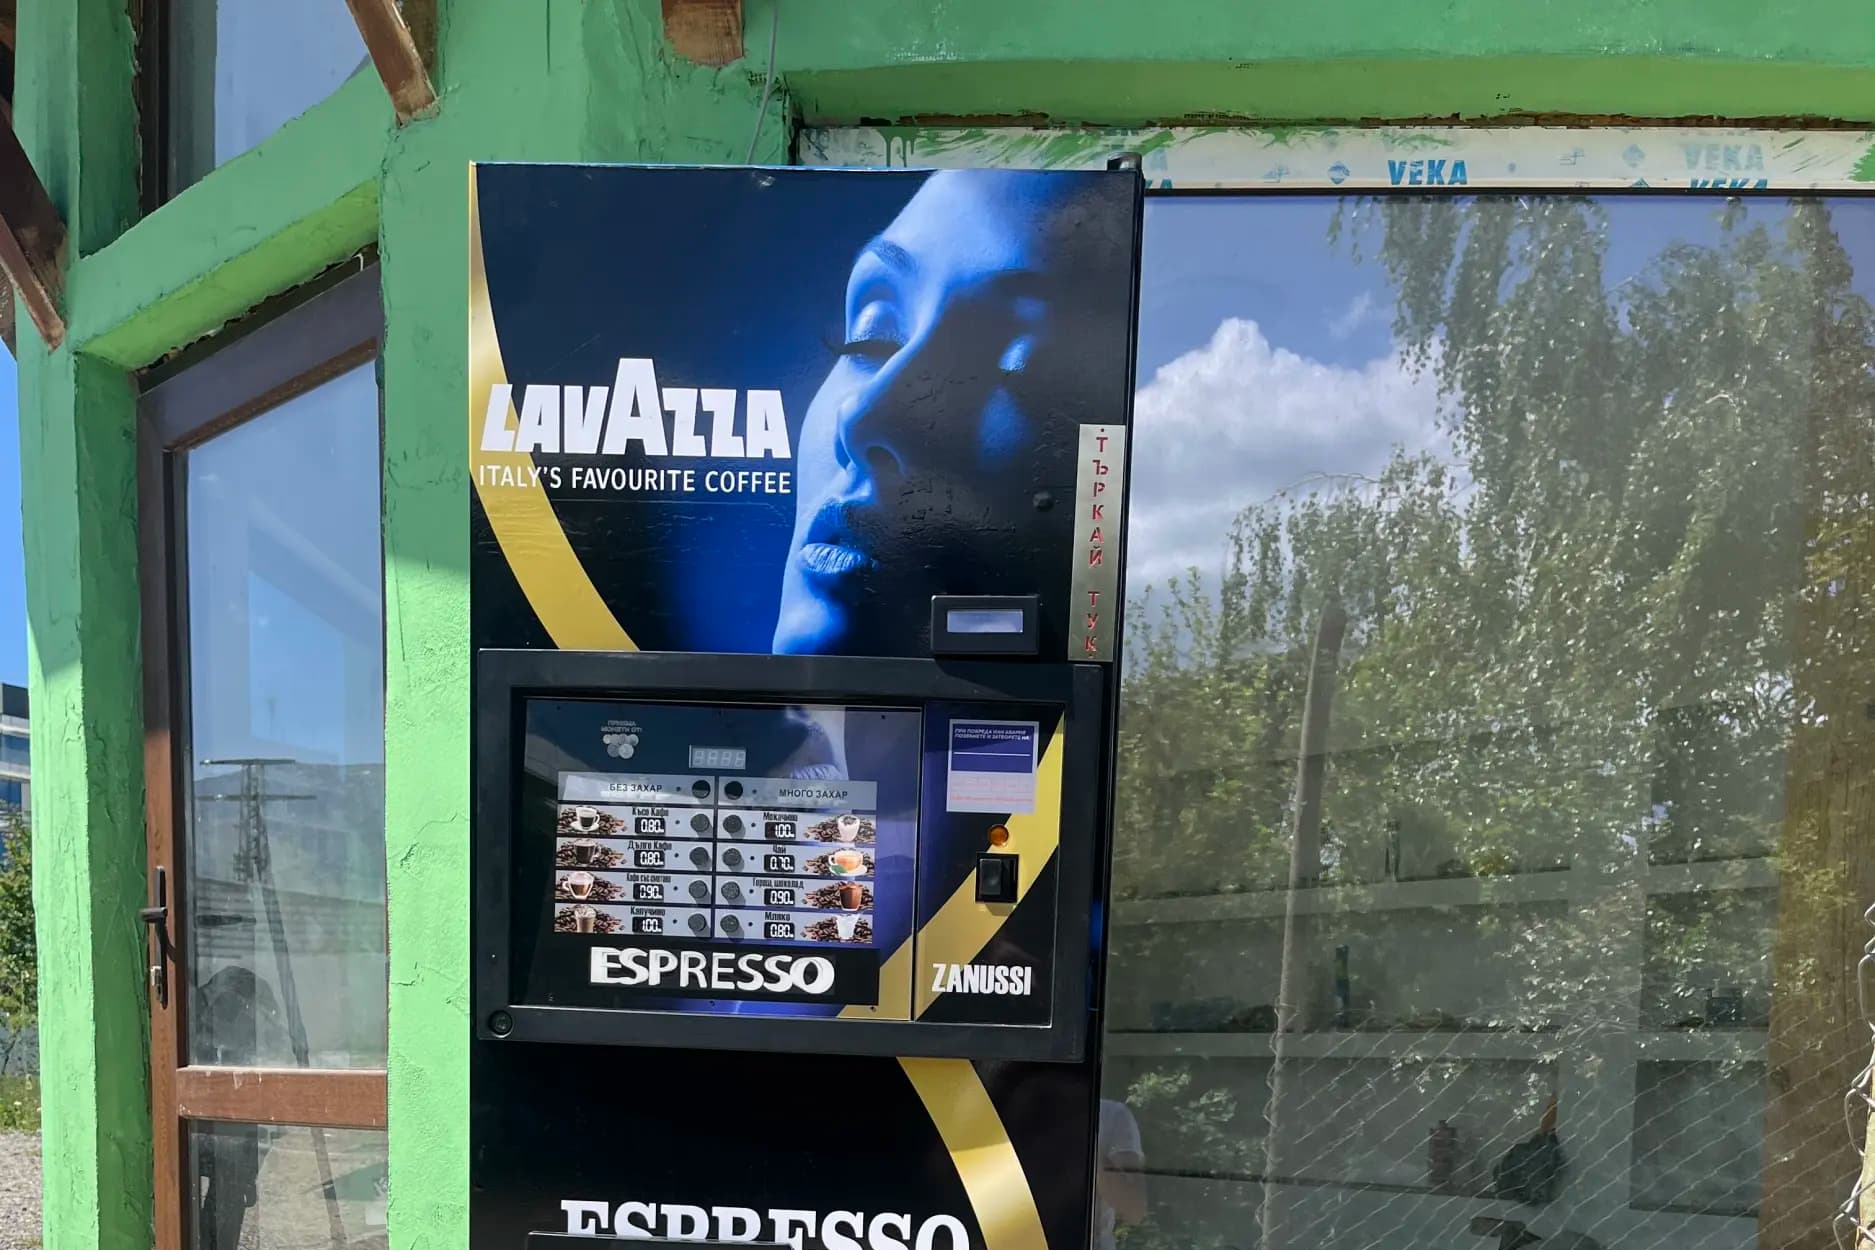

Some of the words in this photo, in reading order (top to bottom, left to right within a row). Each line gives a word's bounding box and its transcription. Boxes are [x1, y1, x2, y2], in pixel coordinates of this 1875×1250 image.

[1387, 159, 1467, 185] VEKA
[480, 357, 792, 459] LAVAZZA
[479, 465, 562, 489] ITALY'S
[571, 466, 696, 492] FAVOURITE
[705, 470, 792, 494] COFFEE
[1088, 436, 1109, 567] ТЪРКАЙ
[1084, 591, 1101, 653] ТУК
[609, 783, 628, 792] БЕЗ
[630, 783, 663, 793] ЗАХАР
[778, 788, 814, 798] МНОГО
[815, 790, 848, 799] ЗАХАР
[627, 840, 652, 850] Дълго
[590, 946, 836, 995] ESPRESSO
[931, 963, 1033, 996] ZANUSSI
